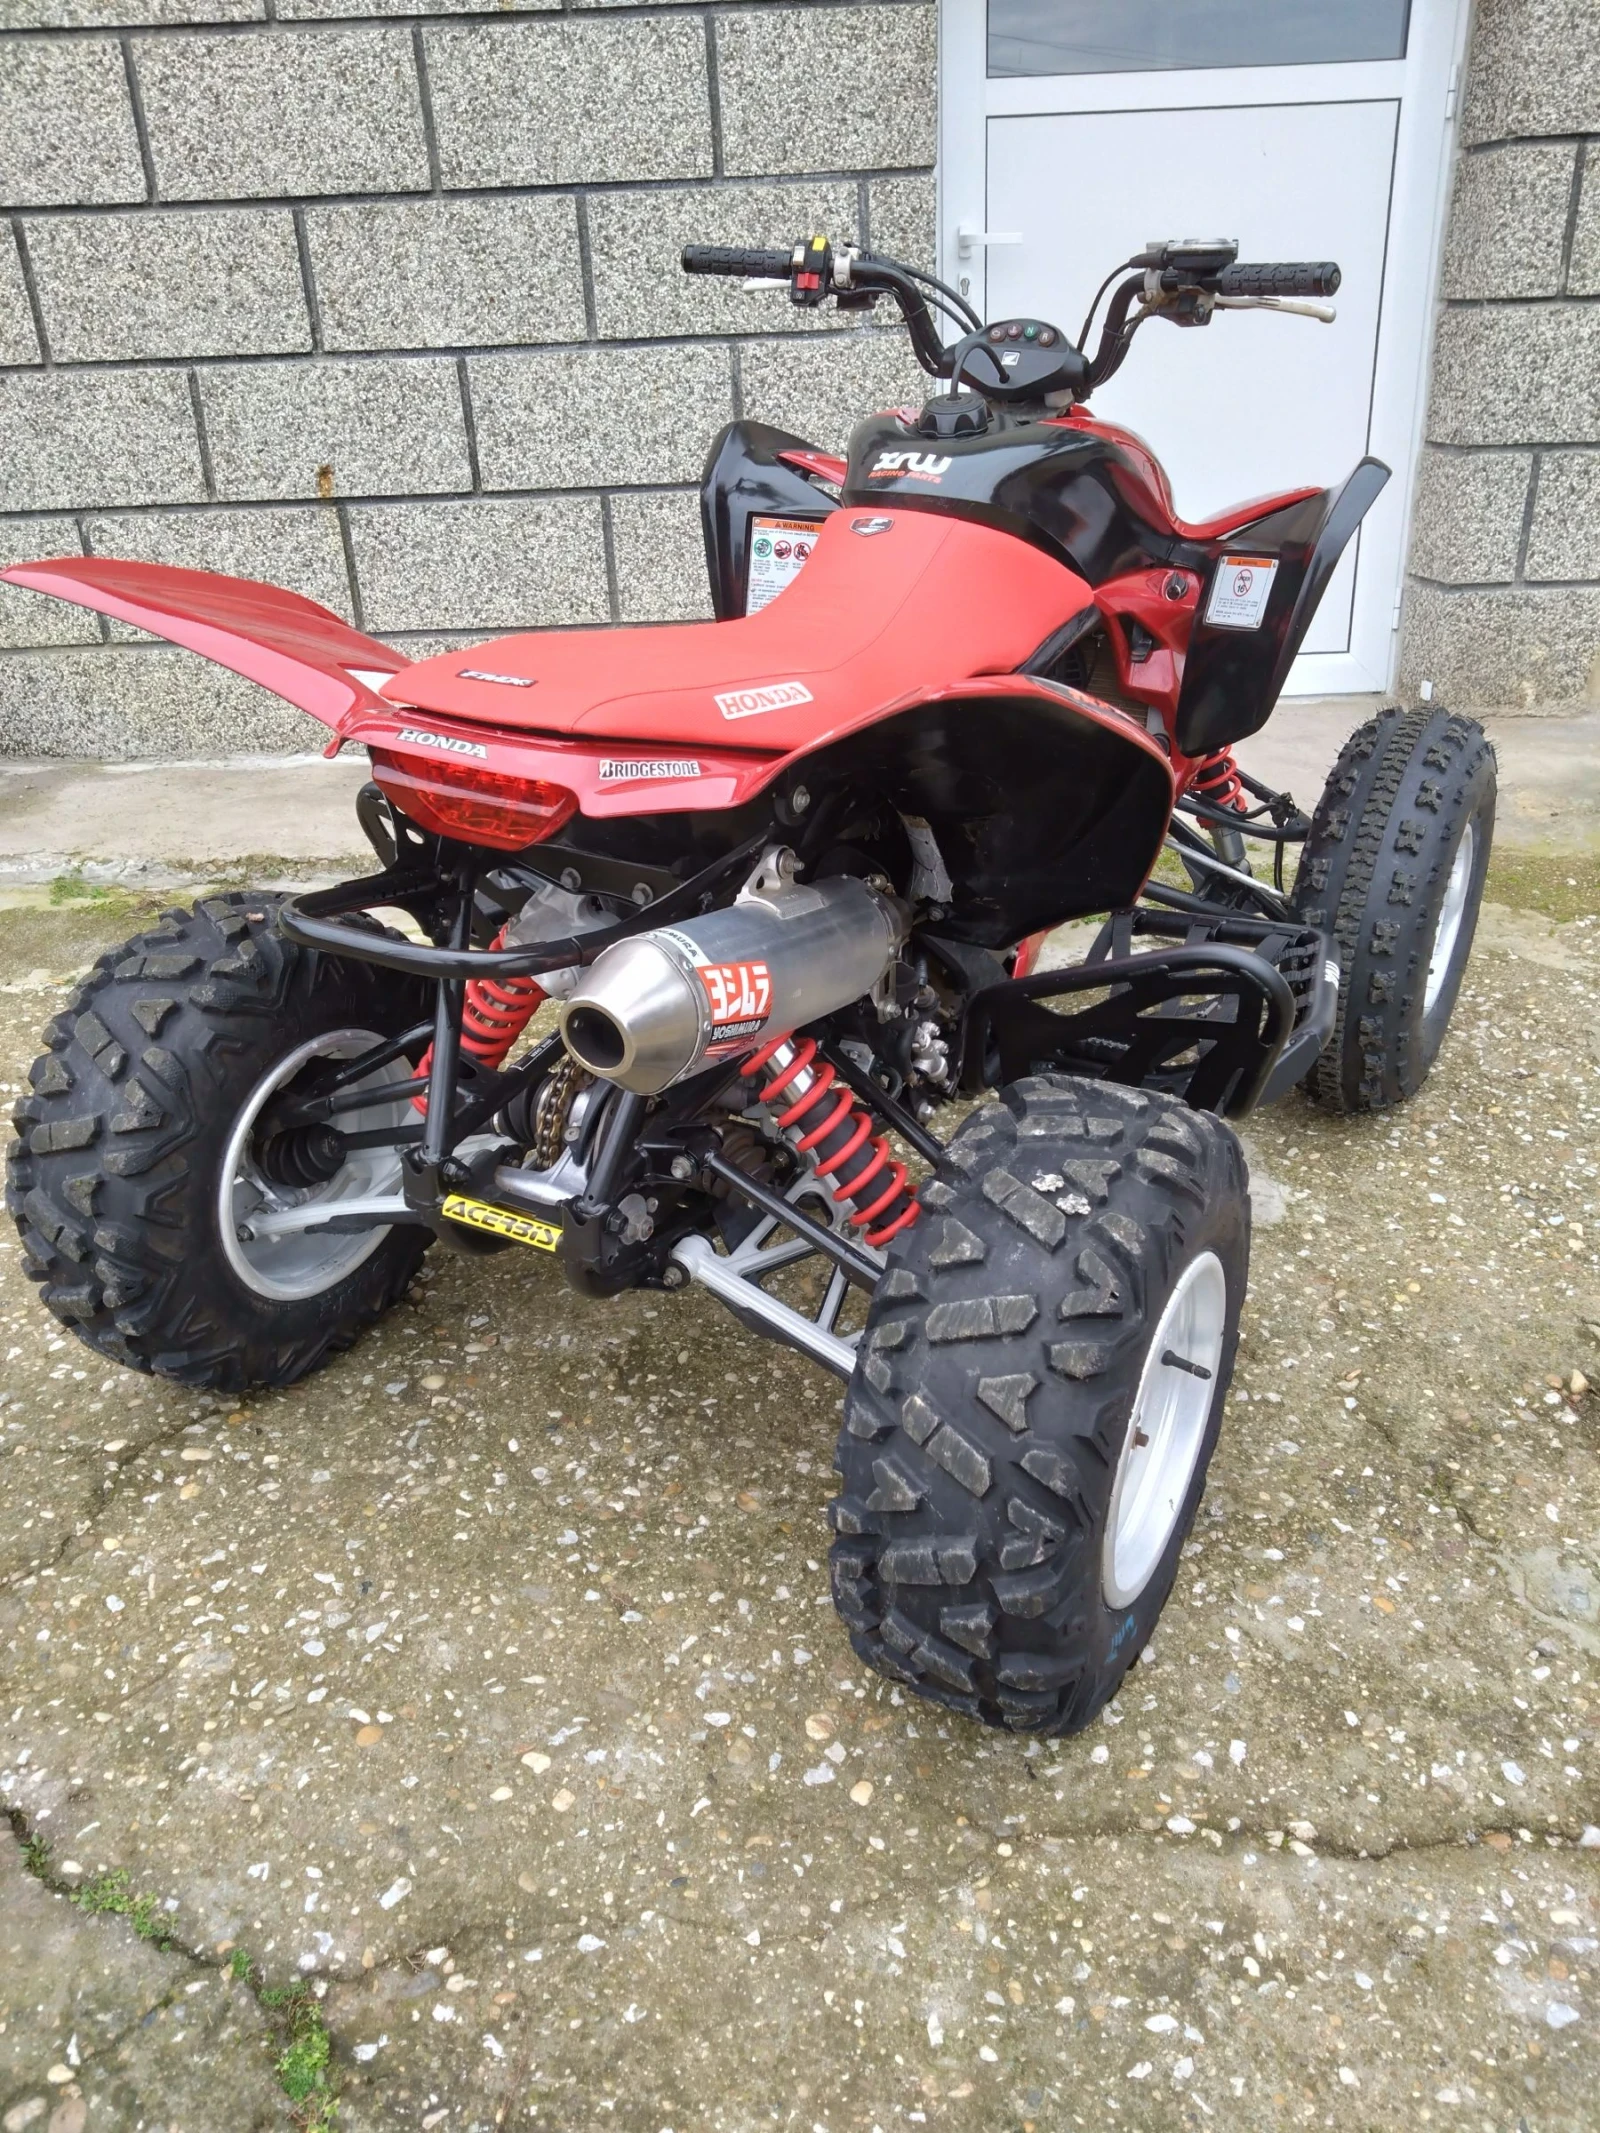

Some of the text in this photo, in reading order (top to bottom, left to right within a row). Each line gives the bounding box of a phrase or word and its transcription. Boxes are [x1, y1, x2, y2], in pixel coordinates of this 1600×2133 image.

[868, 470, 943, 484] RACING PARTS
[782, 521, 815, 531] WARNING
[720, 686, 807, 715] HONDA
[396, 728, 488, 759] HONDA
[601, 761, 699, 778] BRIDGESTONE
[703, 965, 769, 1021] ヨシムラ
[712, 1019, 761, 1040] YOSHIMURA
[445, 1201, 555, 1246] ACERBIS
